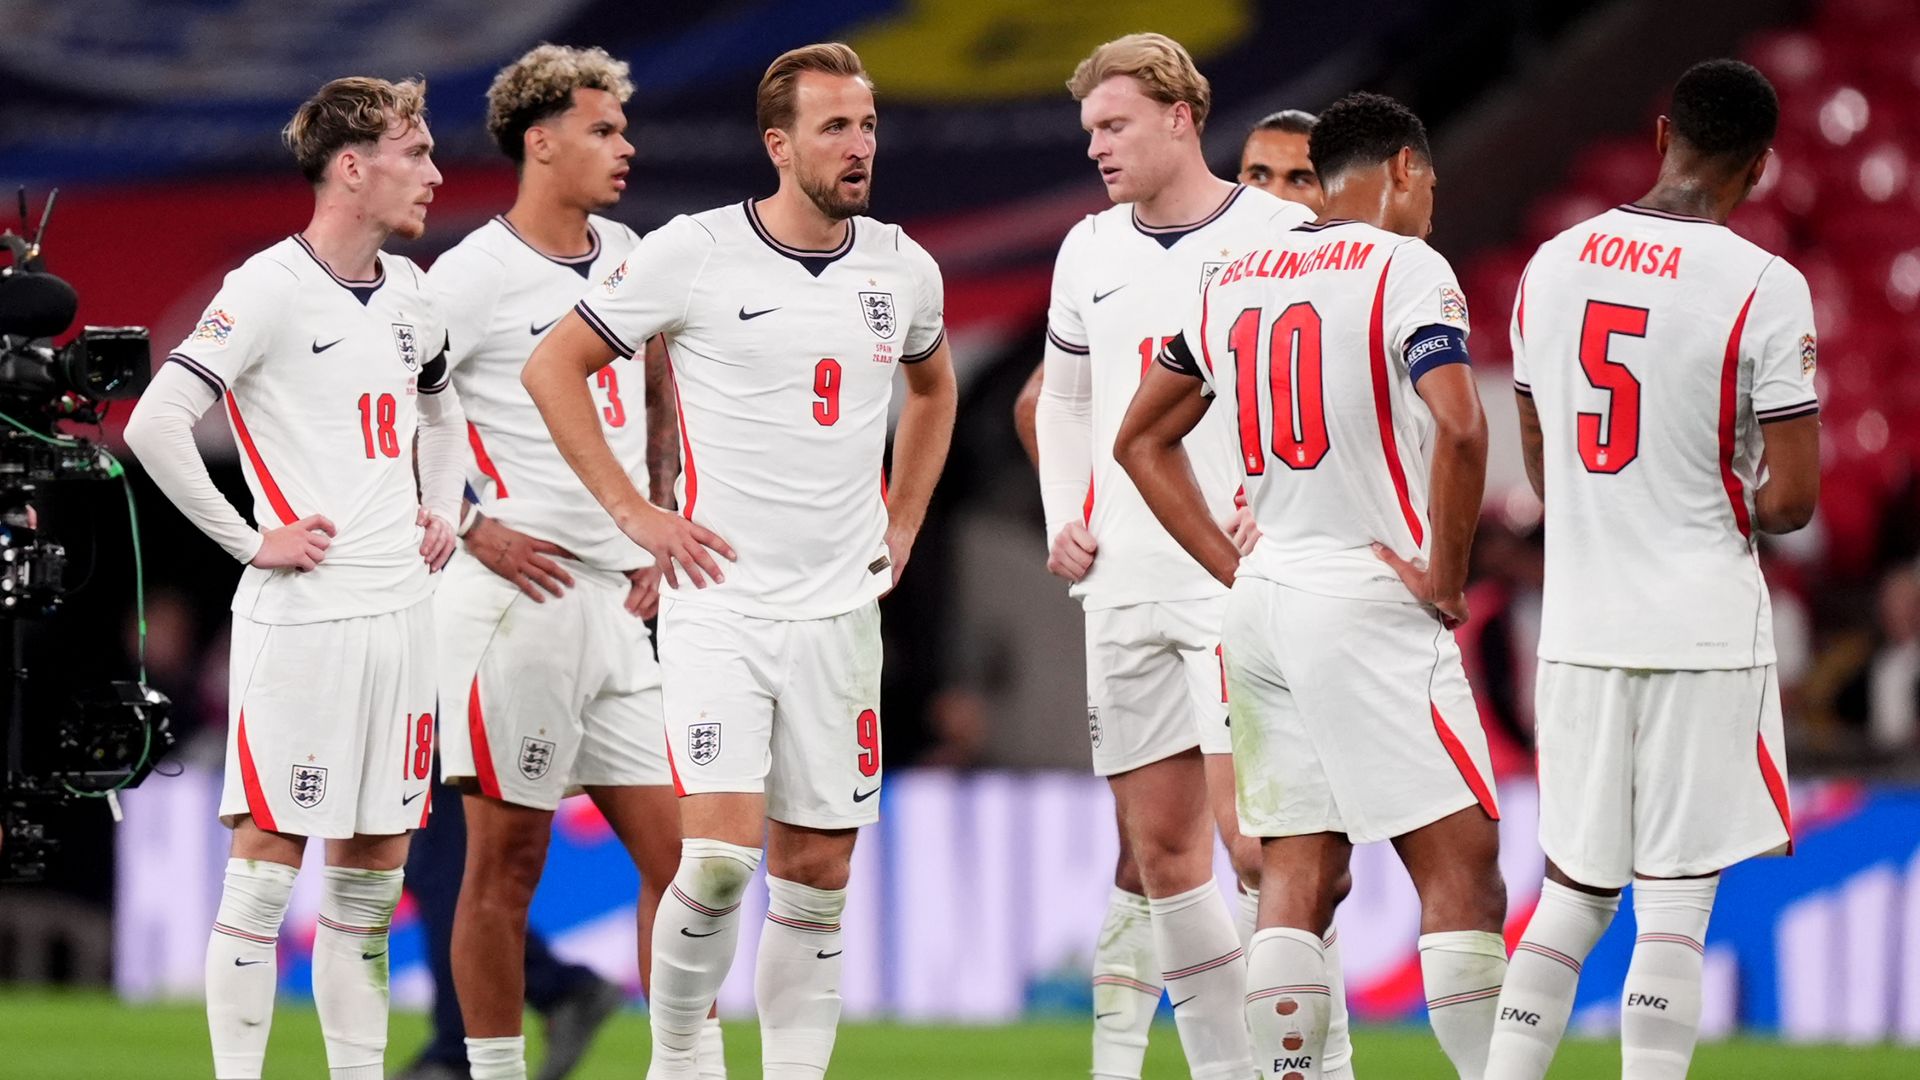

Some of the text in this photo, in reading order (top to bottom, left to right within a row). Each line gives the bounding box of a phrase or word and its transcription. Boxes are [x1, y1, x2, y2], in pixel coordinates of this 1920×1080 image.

[1219, 241, 1374, 286] BELLINGHAM
[1579, 232, 1682, 279] KONSA
[1138, 336, 1176, 381] 1
[1408, 338, 1449, 364] RESPECT
[812, 358, 842, 426] 9
[1228, 301, 1331, 476] 10
[1577, 299, 1650, 474] 5
[358, 393, 400, 459] 18
[403, 713, 433, 780] 18
[856, 708, 880, 777] 9
[1500, 1007, 1541, 1027] ENG
[1627, 993, 1669, 1010] ENG
[1273, 1056, 1312, 1073] ENG
